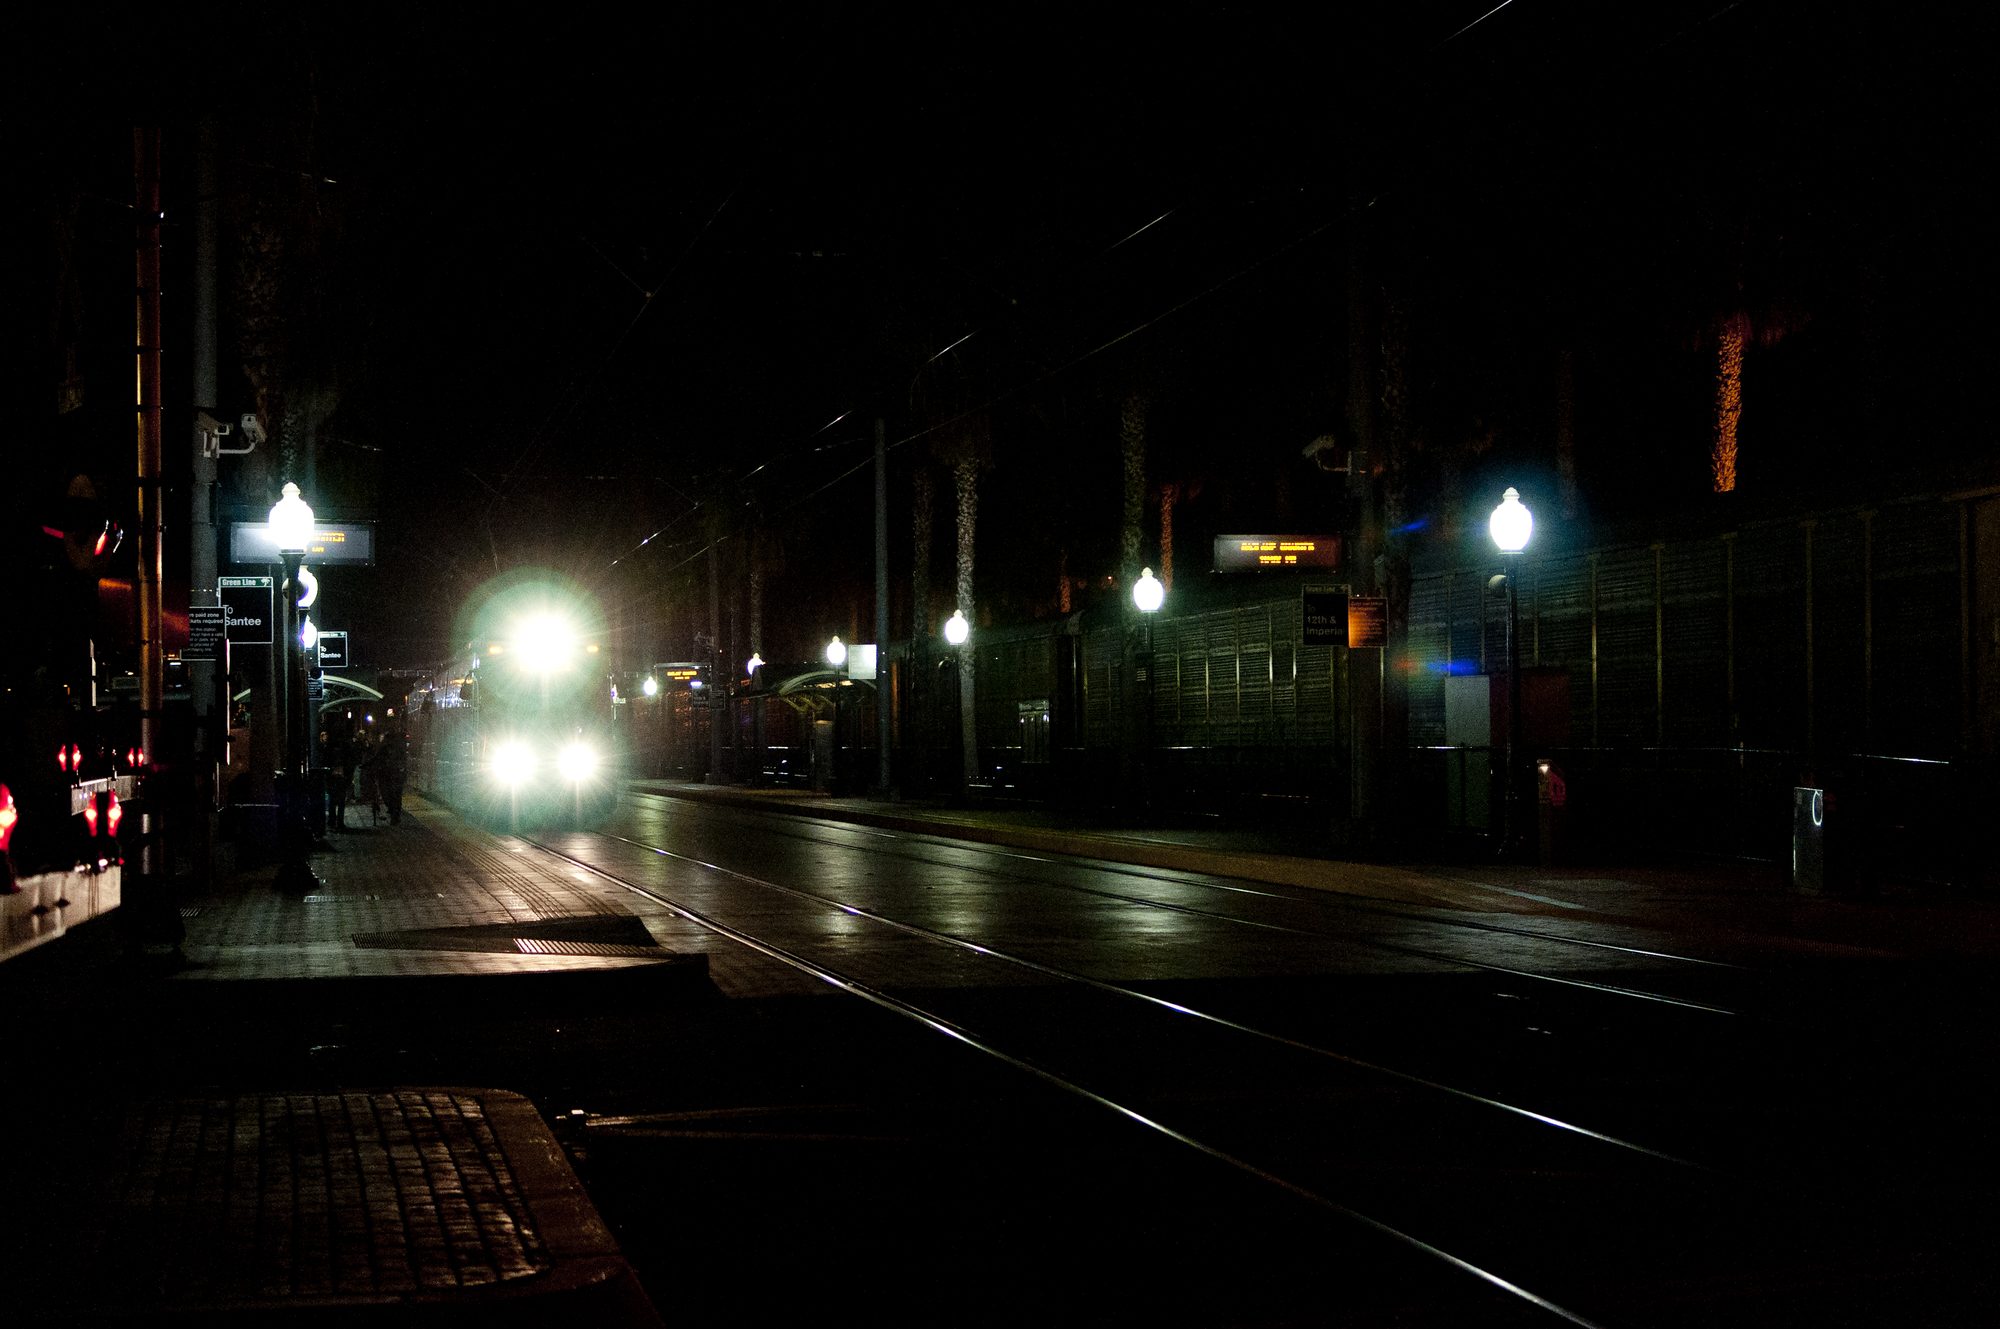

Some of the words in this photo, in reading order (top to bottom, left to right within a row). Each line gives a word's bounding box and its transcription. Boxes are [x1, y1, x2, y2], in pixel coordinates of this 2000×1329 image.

[225, 616, 262, 626] Santee
[1307, 615, 1327, 624] 12th
[1329, 615, 1337, 624] &
